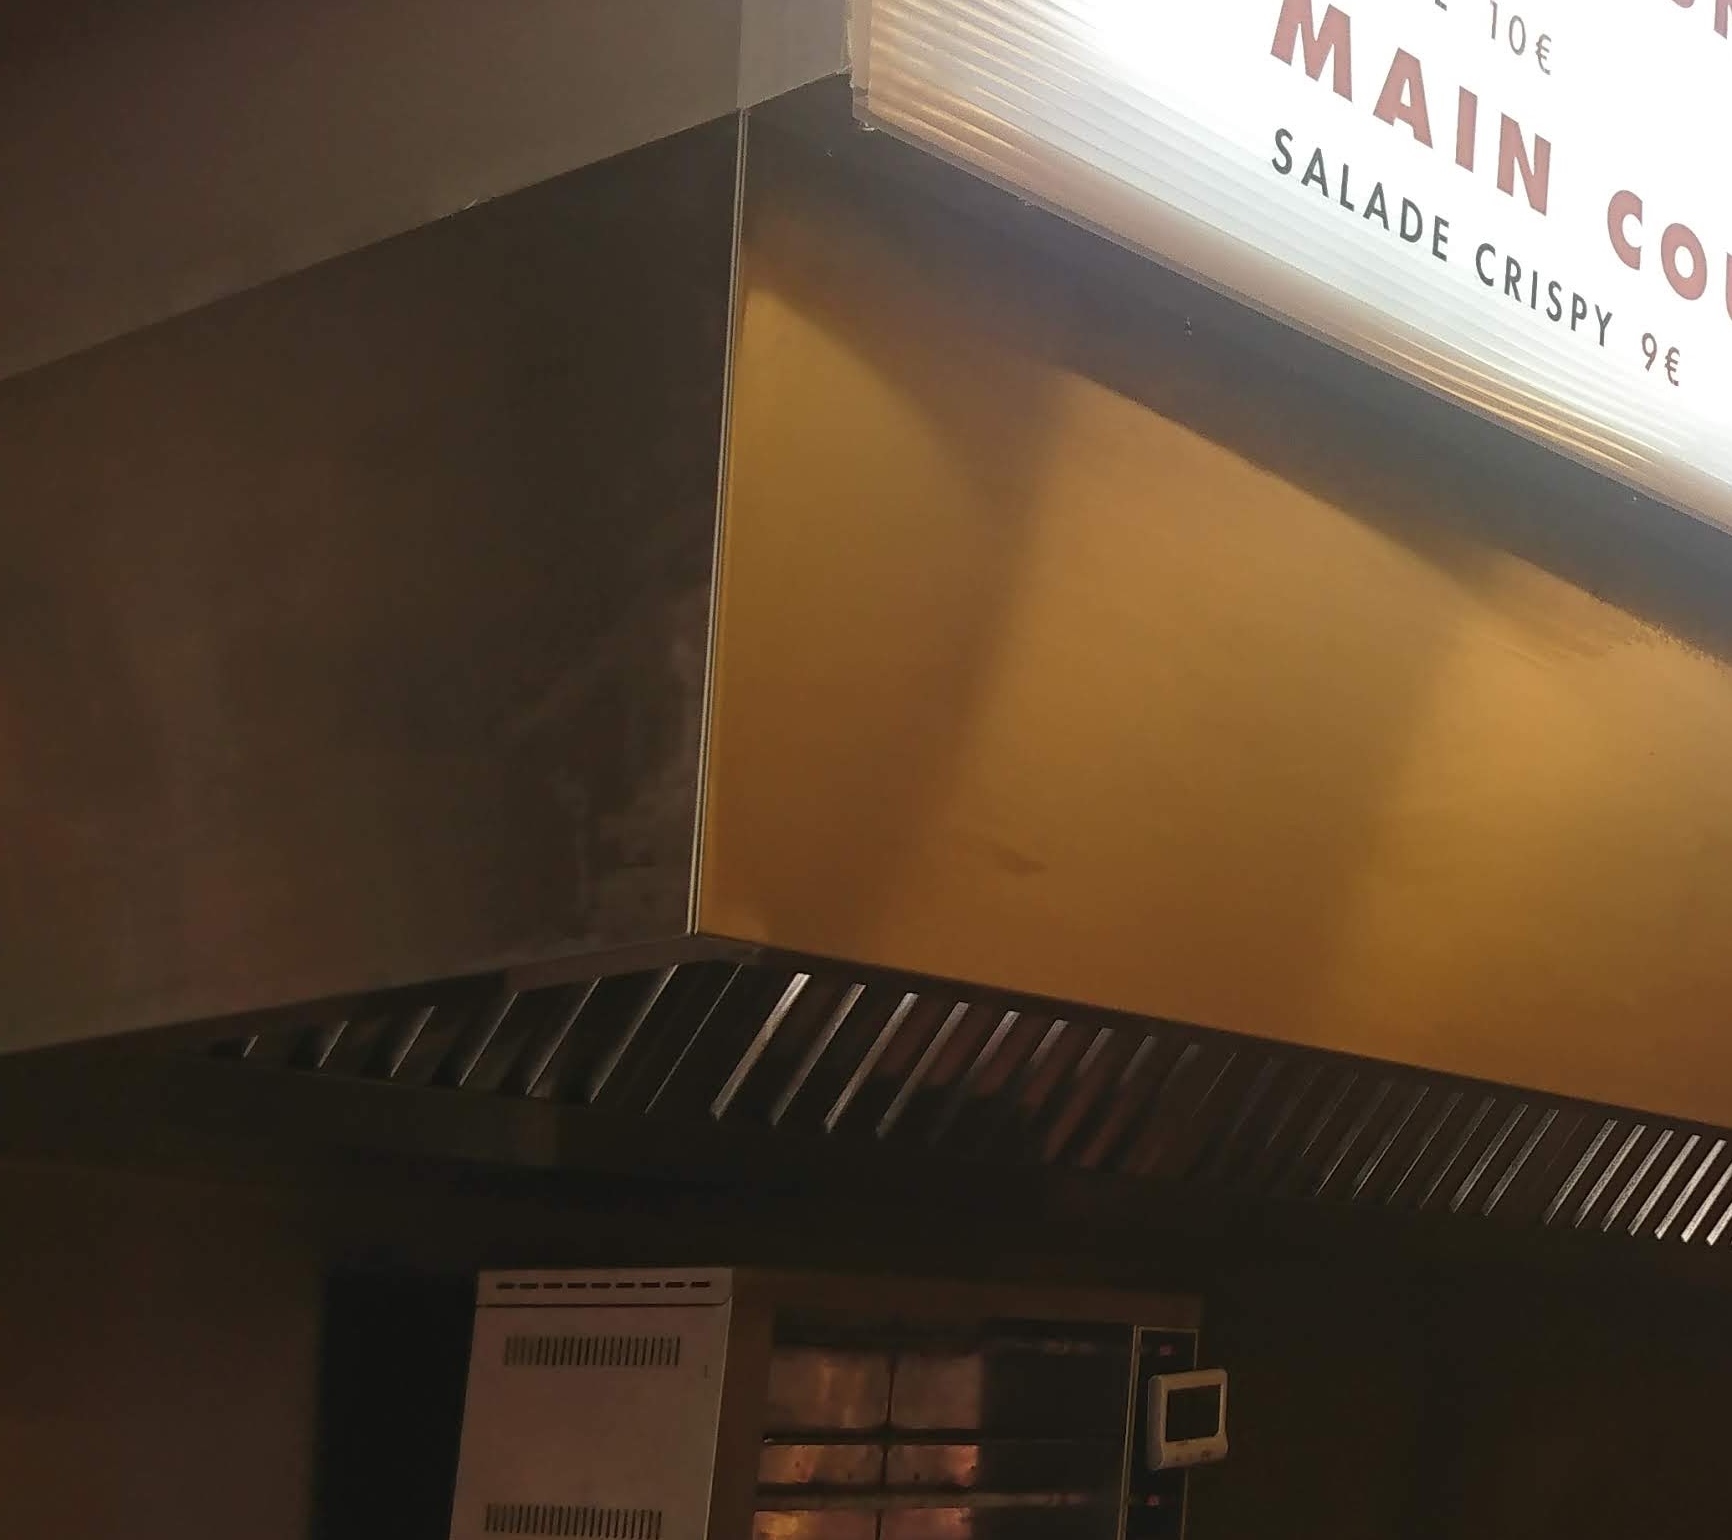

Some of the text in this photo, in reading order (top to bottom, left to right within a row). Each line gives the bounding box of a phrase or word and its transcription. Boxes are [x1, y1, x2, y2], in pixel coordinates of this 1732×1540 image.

[1489, 0, 1553, 76] 10€
[1271, 127, 1681, 386] SALADE CRISPY 9€
